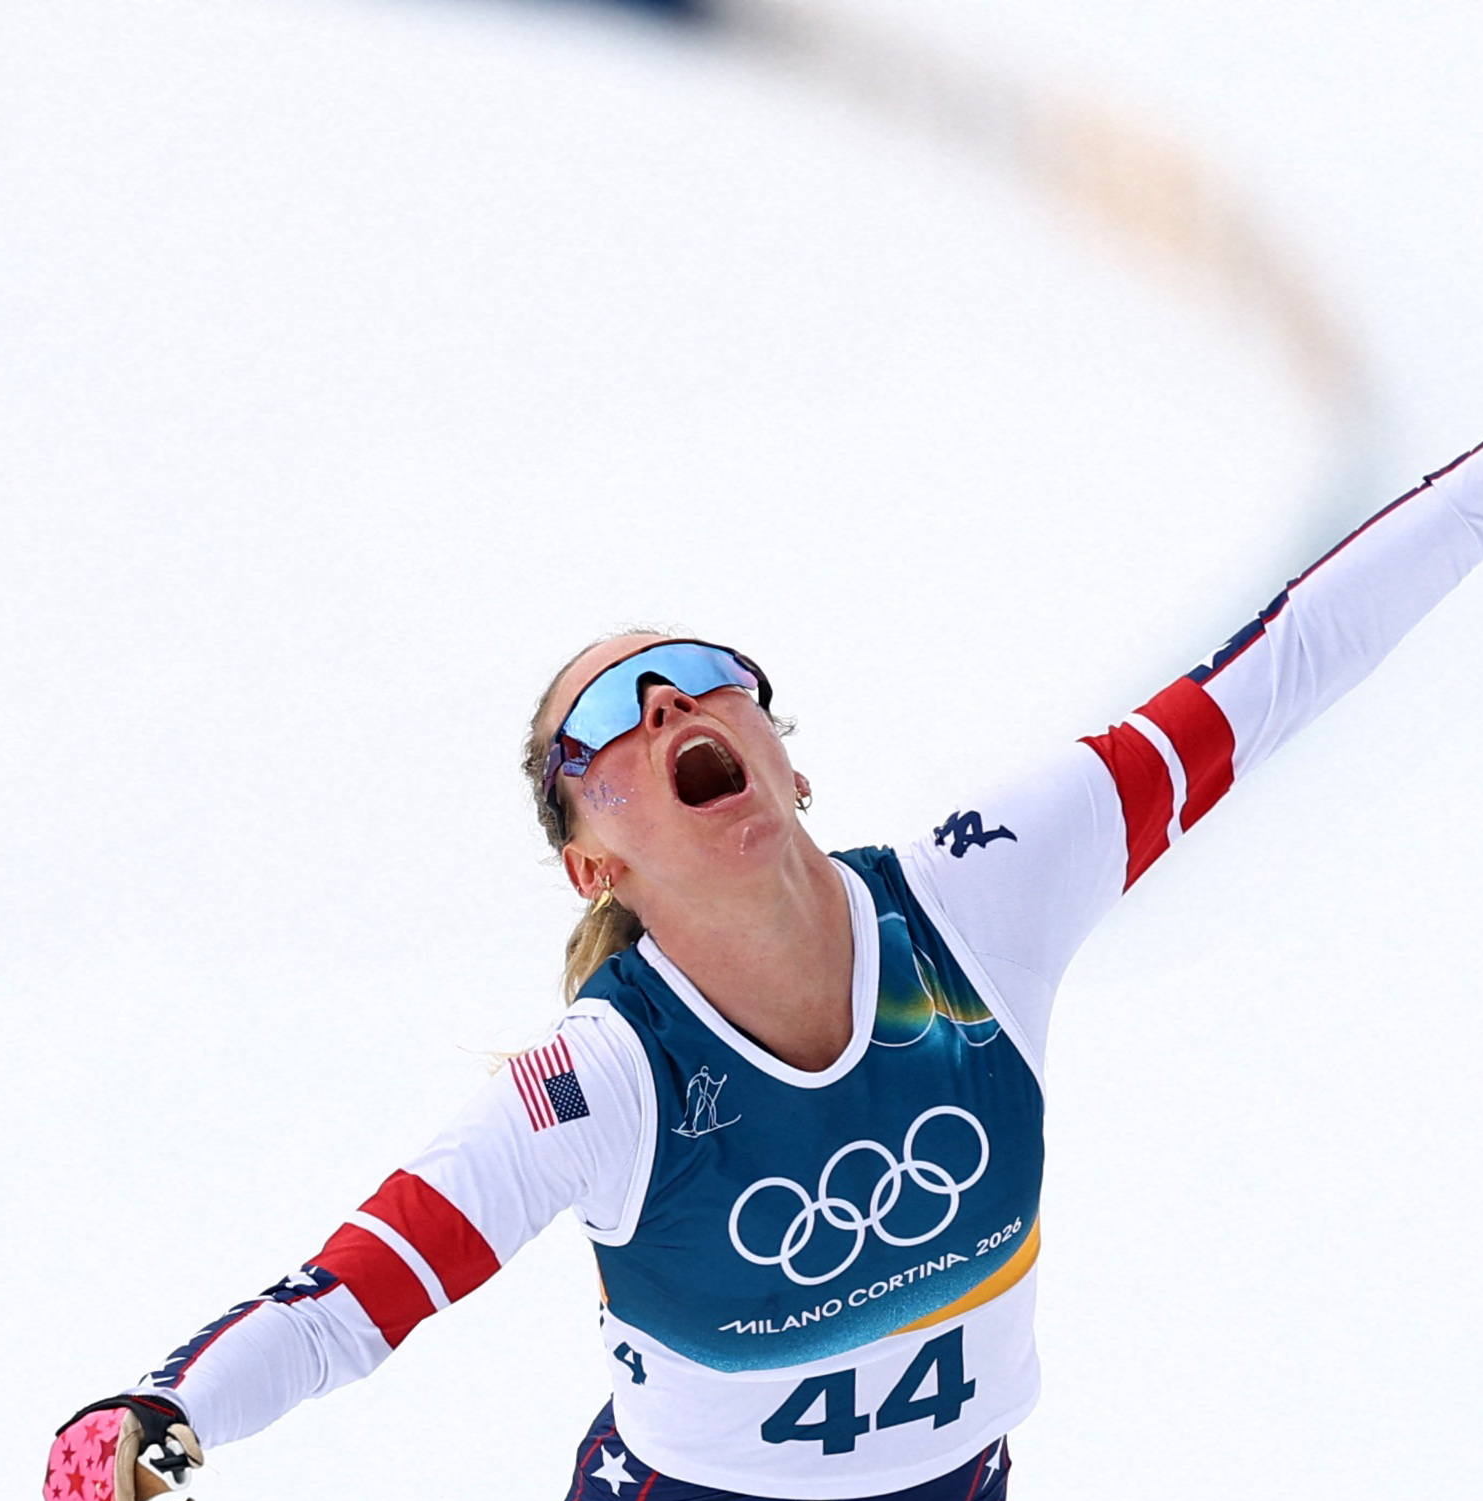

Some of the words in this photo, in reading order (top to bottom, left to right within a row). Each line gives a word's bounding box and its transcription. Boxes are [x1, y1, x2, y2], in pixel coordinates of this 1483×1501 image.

[718, 1298, 843, 1335] MILANO
[847, 1252, 969, 1307] CORTINA
[974, 1216, 1023, 1257] 2026
[760, 1325, 976, 1456] 44
